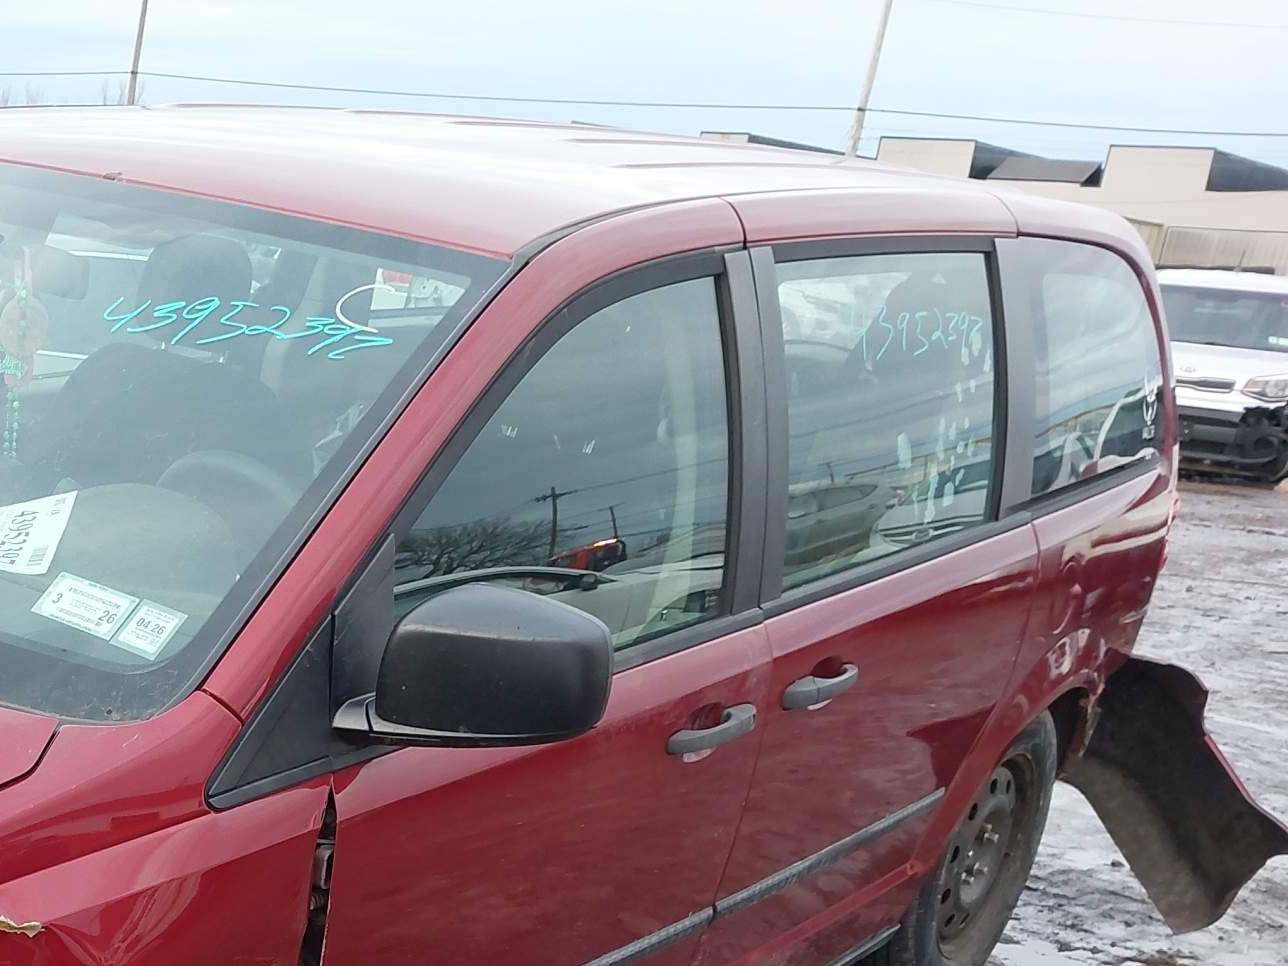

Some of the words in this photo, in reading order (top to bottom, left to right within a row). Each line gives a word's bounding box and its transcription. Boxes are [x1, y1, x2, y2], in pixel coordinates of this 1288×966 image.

[103, 296, 394, 360] 43952397
[51, 592, 63, 604] 3
[97, 609, 118, 625] 26
